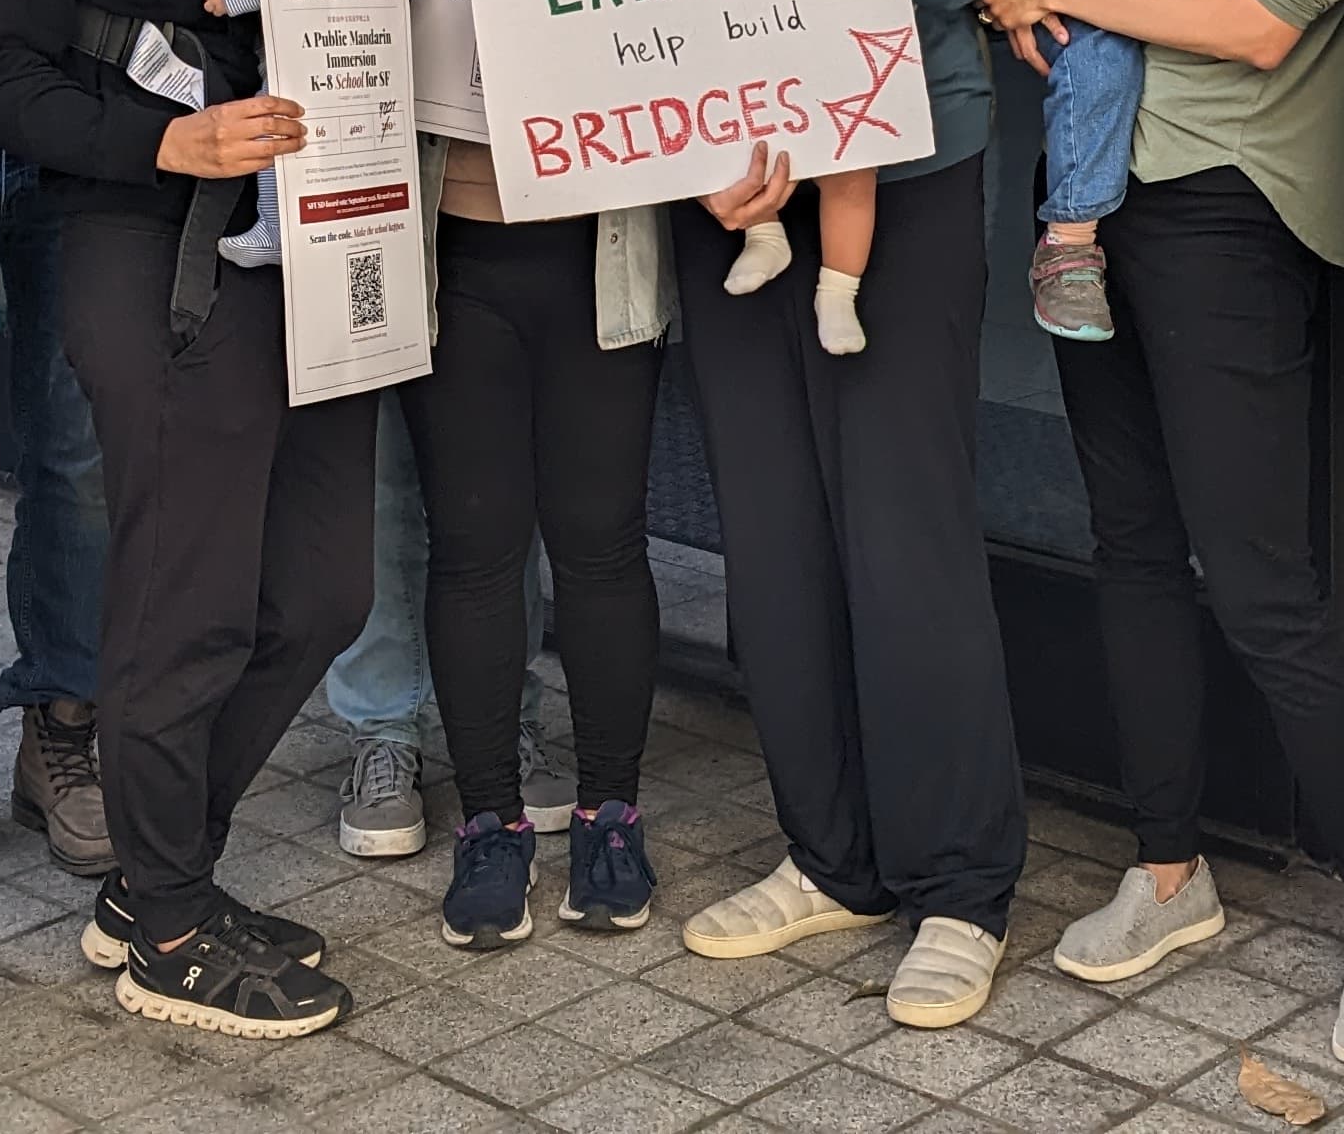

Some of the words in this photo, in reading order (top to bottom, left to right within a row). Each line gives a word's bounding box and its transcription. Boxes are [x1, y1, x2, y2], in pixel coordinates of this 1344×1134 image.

[302, 32, 312, 48] A
[313, 30, 348, 48] Public
[350, 27, 392, 46] Mandarin
[613, 27, 685, 67] help
[723, 0, 806, 40] build
[326, 49, 376, 69] Immersion
[336, 71, 364, 91] School
[365, 70, 377, 88] for
[378, 70, 391, 87] SF
[315, 125, 327, 138] 66
[521, 77, 810, 179] BRIDGES
[309, 233, 327, 245] Scan
[327, 231, 338, 242] the
